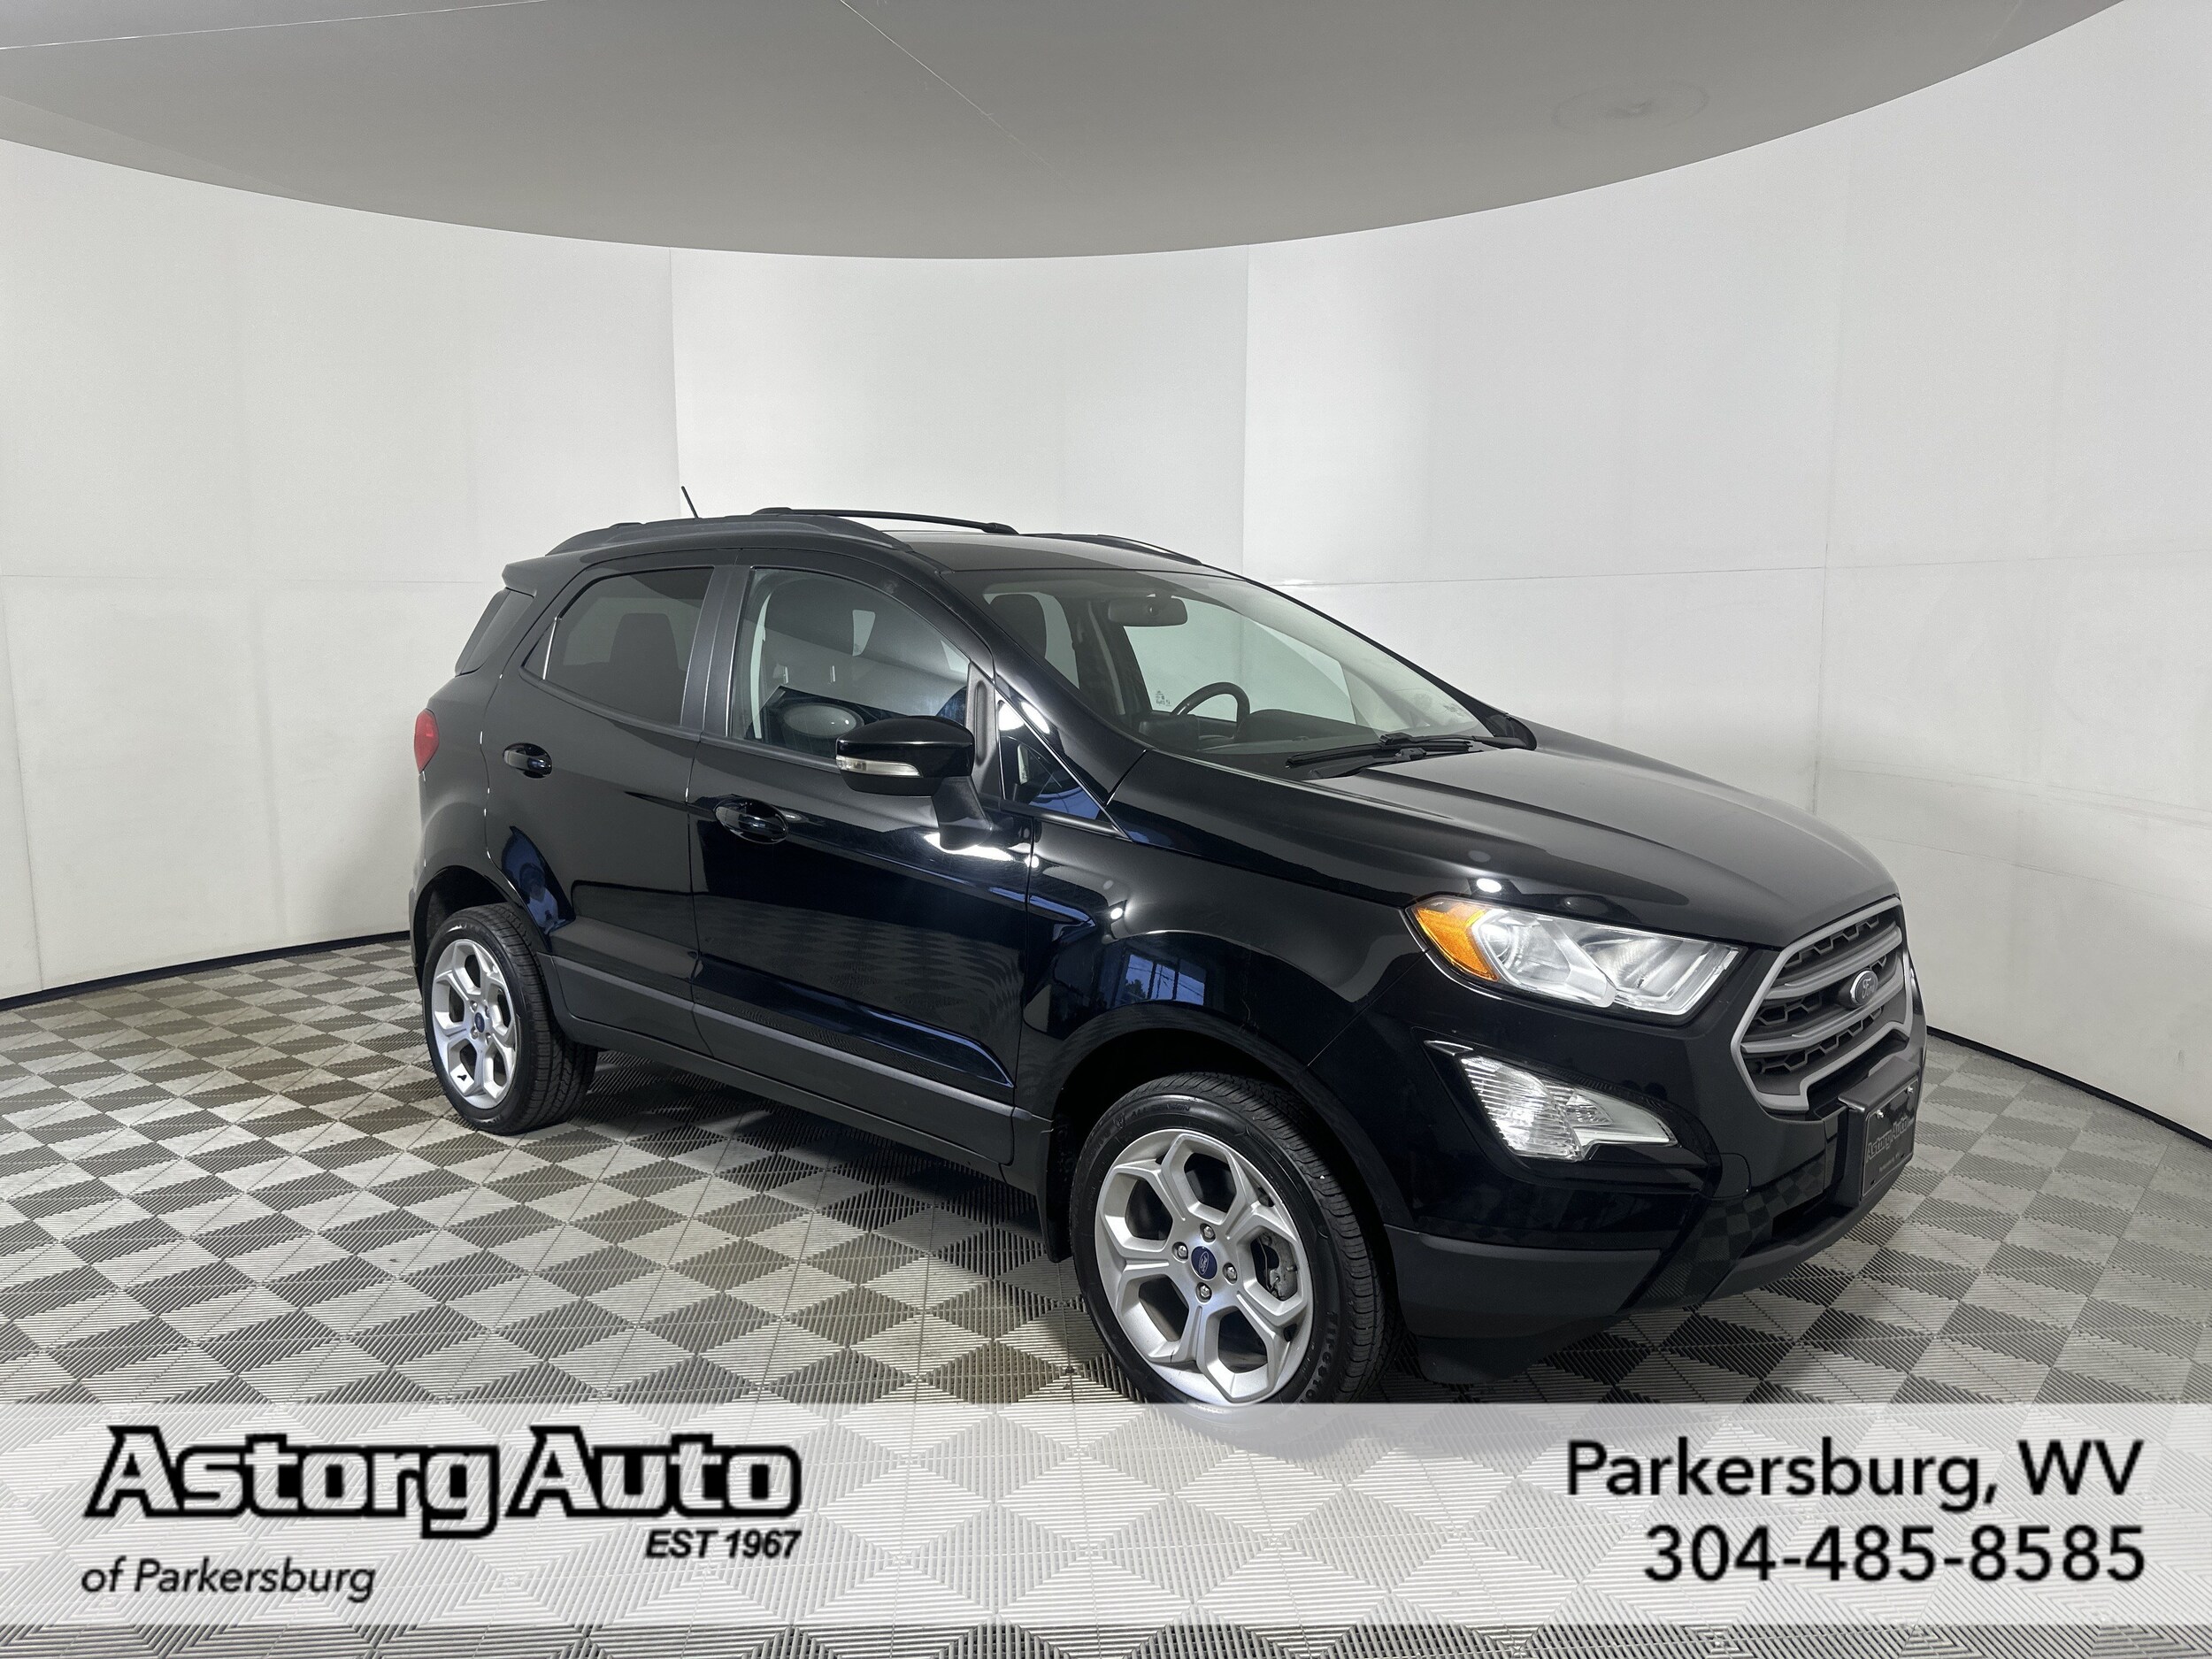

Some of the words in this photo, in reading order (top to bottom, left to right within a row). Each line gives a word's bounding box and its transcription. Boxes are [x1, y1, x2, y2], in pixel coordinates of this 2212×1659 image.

[1862, 977, 1875, 999] Ford
[1866, 1129, 1893, 1164] Astorg
[1892, 1115, 1909, 1140] Auto
